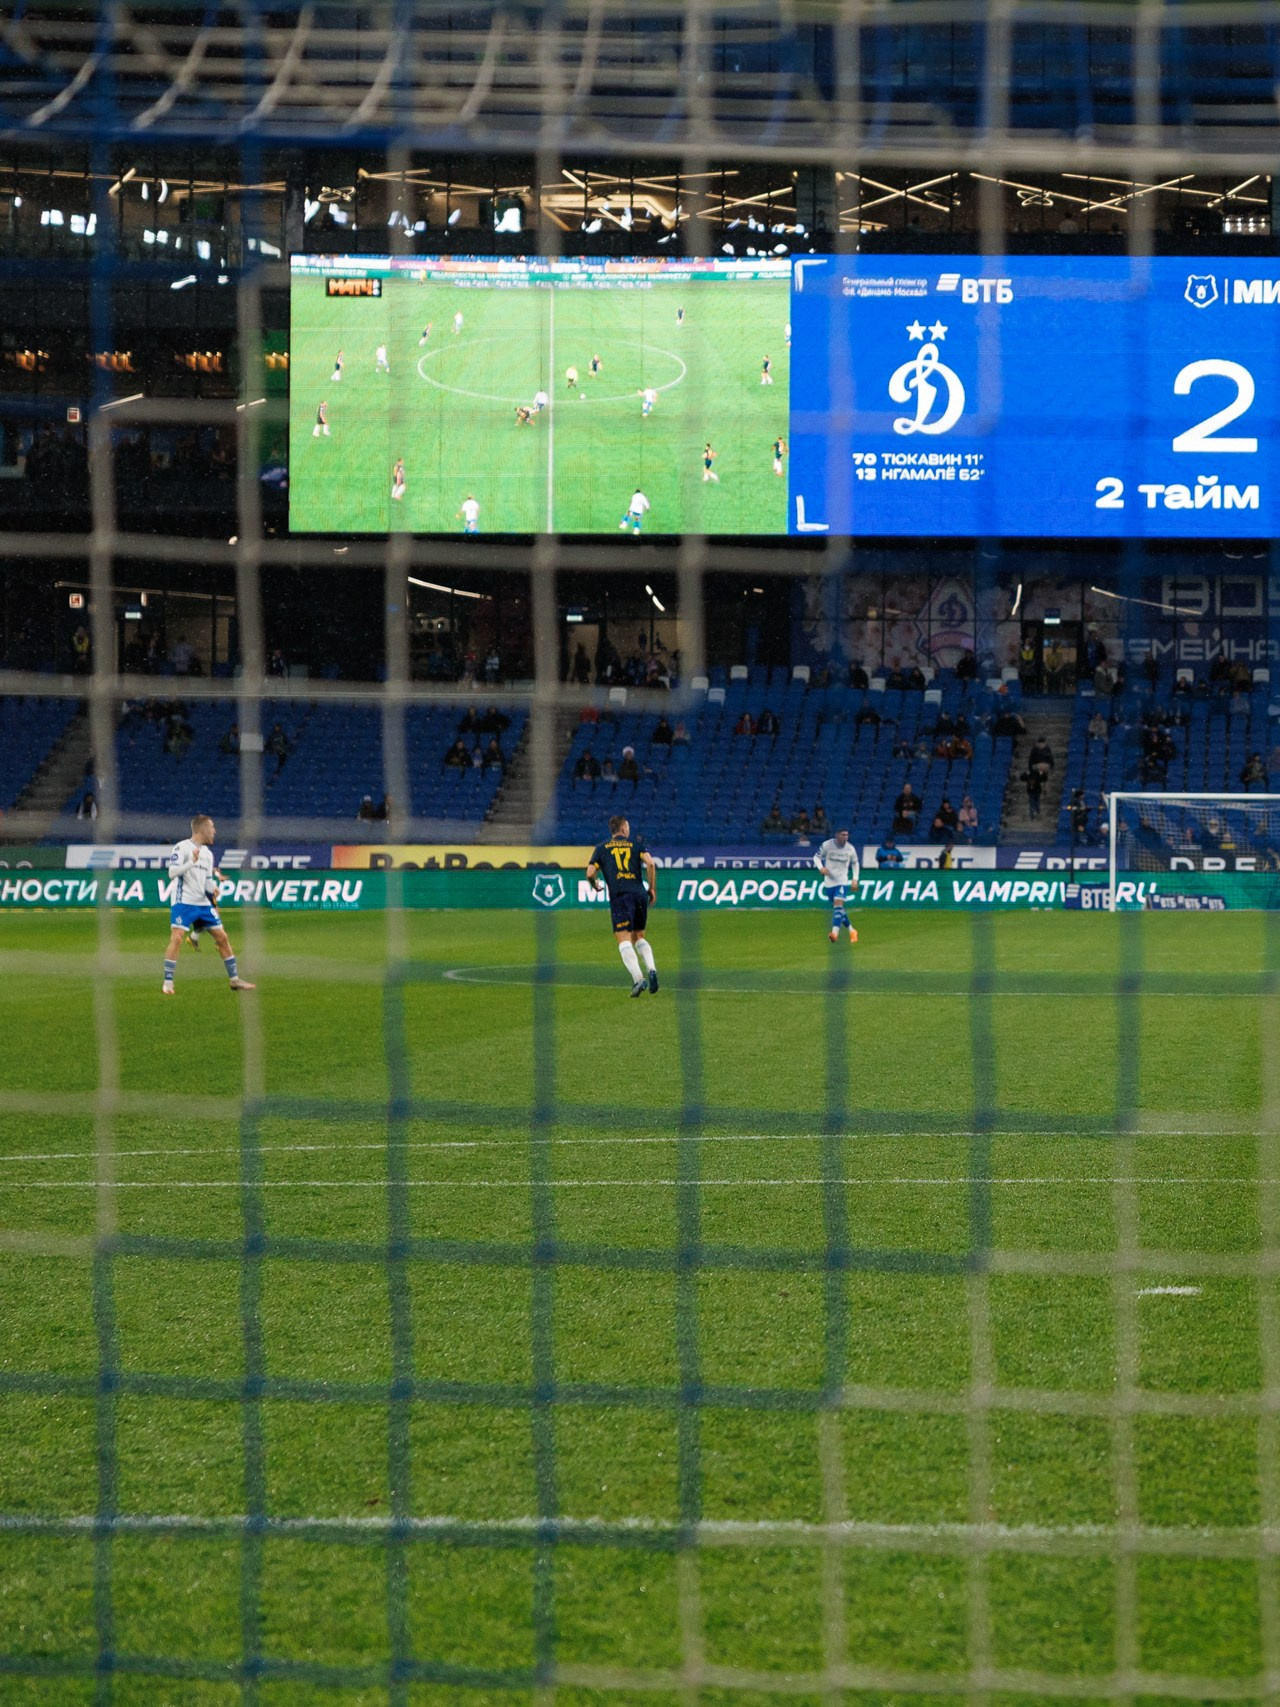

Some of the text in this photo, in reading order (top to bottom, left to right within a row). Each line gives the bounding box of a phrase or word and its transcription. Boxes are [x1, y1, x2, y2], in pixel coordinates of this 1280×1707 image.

[962, 279, 1013, 303] ВТБ
[852, 452, 877, 466] 70
[881, 453, 962, 466] ТЮКАВИН
[881, 466, 956, 480] НГАМАЛЁ
[1095, 475, 1260, 509] 2 тайм
[610, 847, 631, 871] 17
[0, 879, 363, 902] НОСТИ НА VPRIVET.RU
[900, 879, 939, 901] НА
[952, 879, 1157, 903] VAMPRIRU
[1081, 888, 1111, 909] ВТБ
